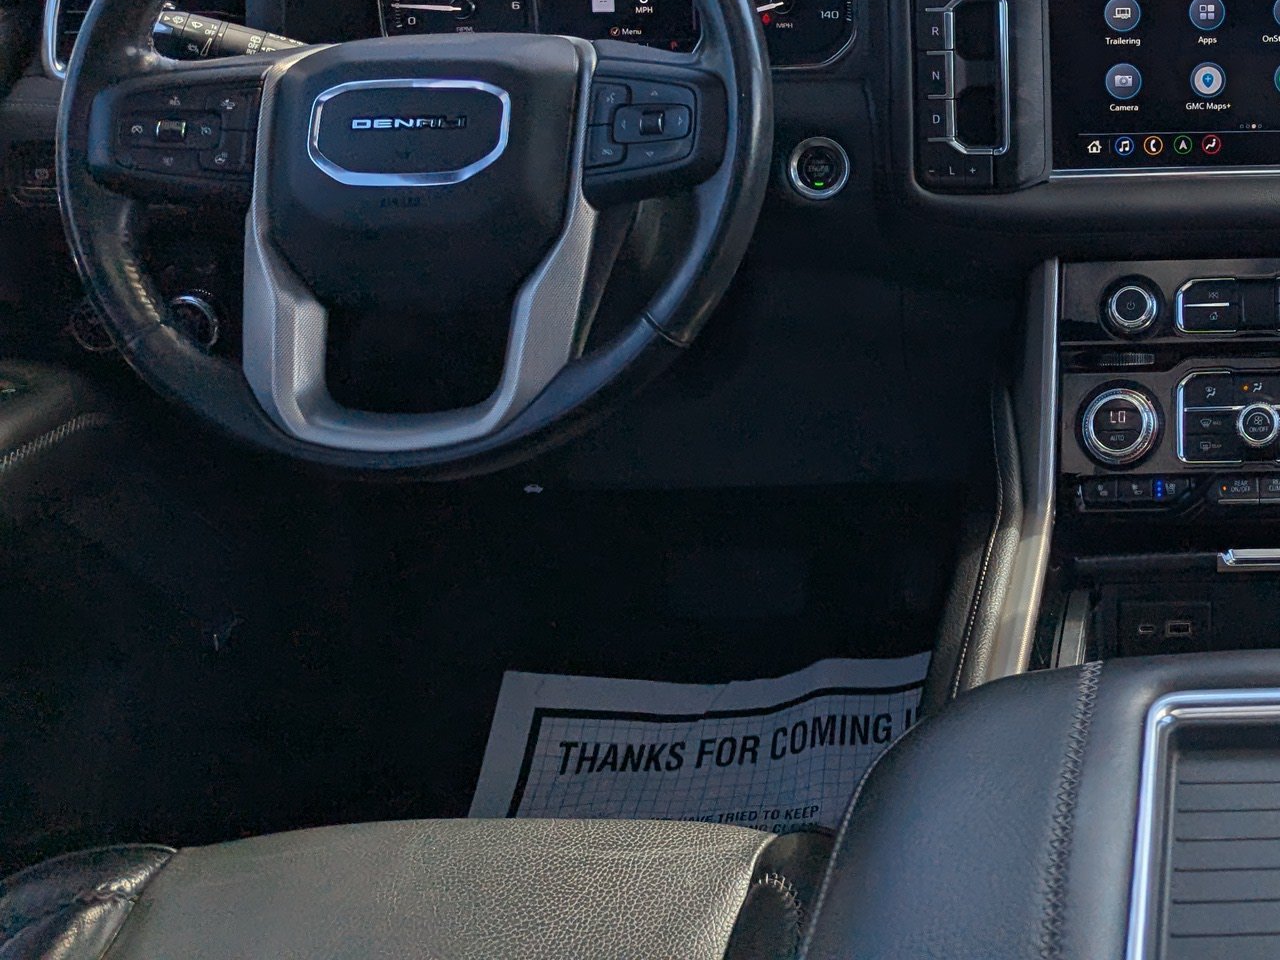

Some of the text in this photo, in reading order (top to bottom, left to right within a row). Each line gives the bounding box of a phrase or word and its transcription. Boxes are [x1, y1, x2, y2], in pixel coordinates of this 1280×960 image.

[511, 1, 521, 10] 6
[820, 10, 839, 19] 140
[407, 16, 416, 25] 0
[204, 28, 216, 36] OFF
[931, 26, 939, 36] R
[1105, 37, 1141, 47] Trailering
[1198, 36, 1218, 45] Apps
[932, 72, 940, 80] N
[1109, 103, 1139, 112] Camera
[1185, 102, 1231, 112] GMC Maps+
[351, 115, 467, 130] DENALI
[932, 115, 941, 124] D
[1110, 411, 1126, 424] LO
[558, 740, 685, 775] THANKS
[695, 736, 760, 769] FOR
[770, 713, 892, 760] COMING
[718, 810, 758, 824] TRIED
[764, 808, 781, 821] TO
[785, 805, 820, 820] KEEP
